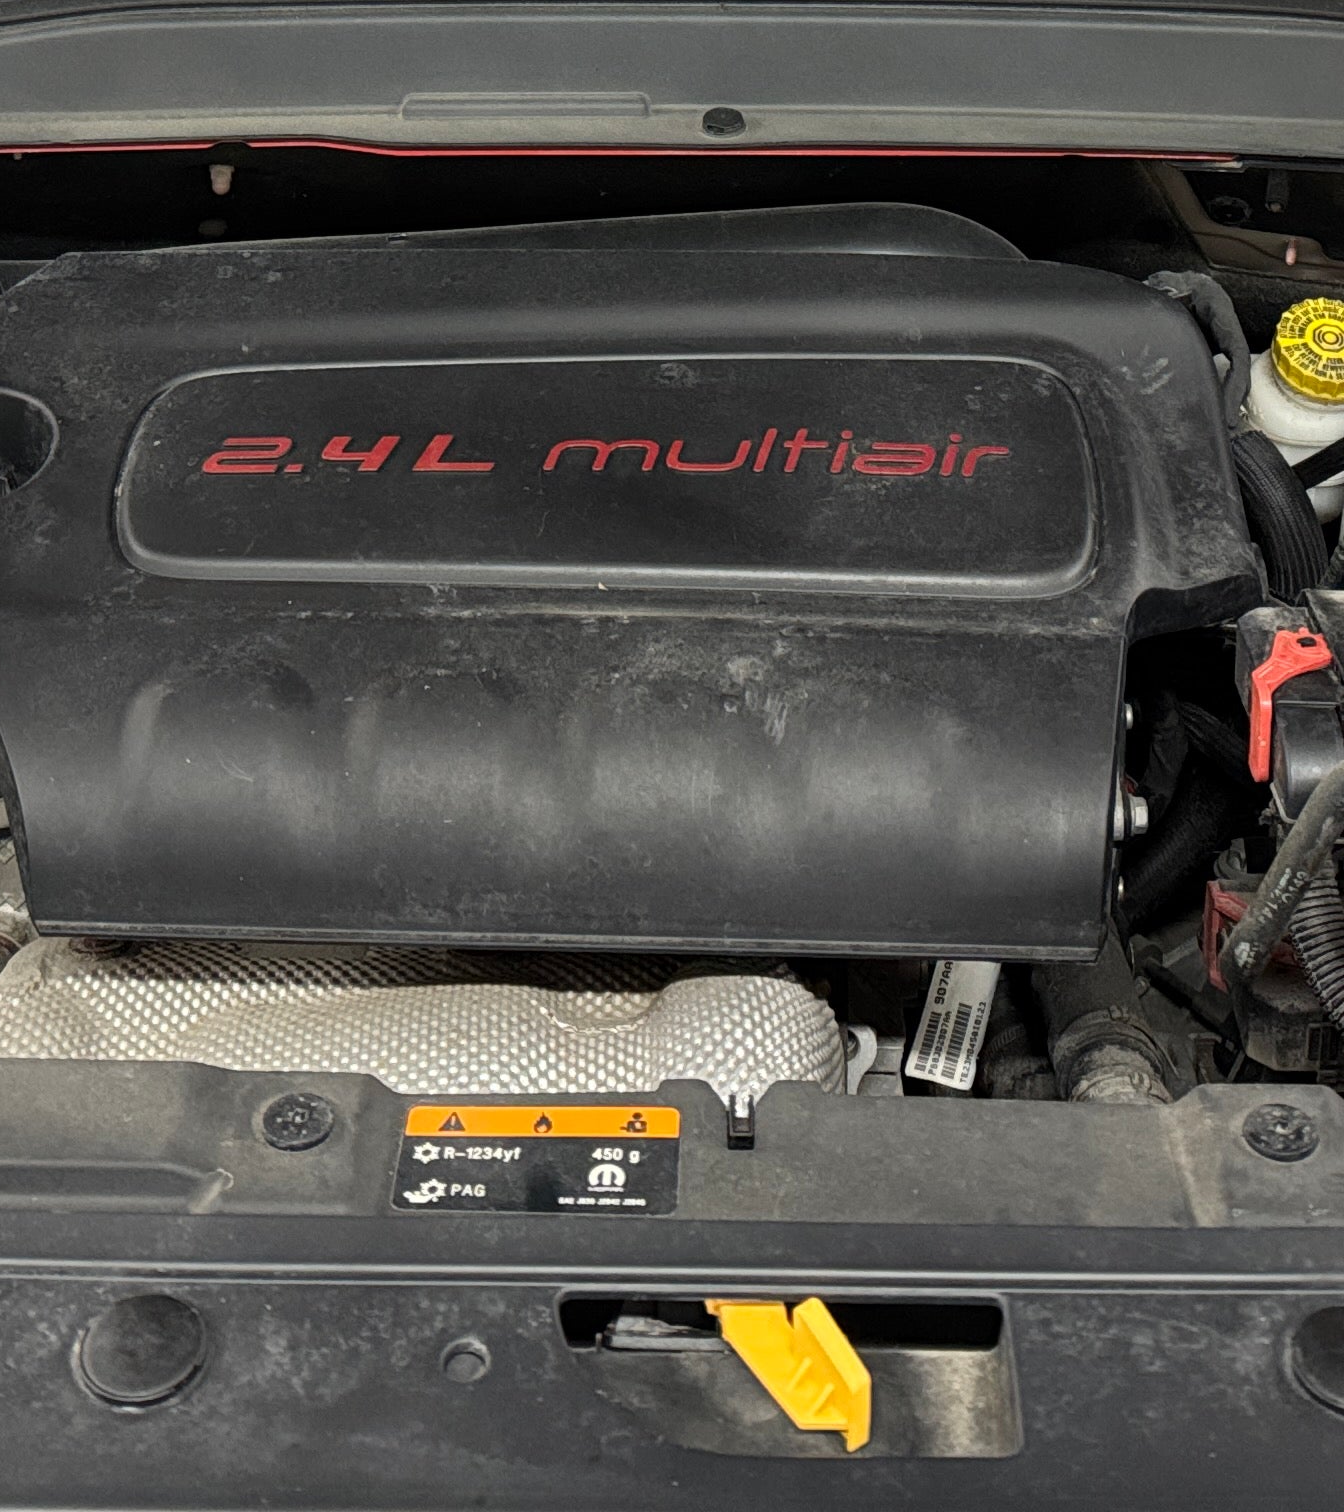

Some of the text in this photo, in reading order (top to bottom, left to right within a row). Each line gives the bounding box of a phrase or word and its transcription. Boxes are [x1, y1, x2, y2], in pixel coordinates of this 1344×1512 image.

[542, 427, 1012, 480] multiair
[934, 961, 954, 1006] 907AA
[443, 1146, 641, 1164] R-1234yf 450 g
[450, 1183, 487, 1198] PAG
